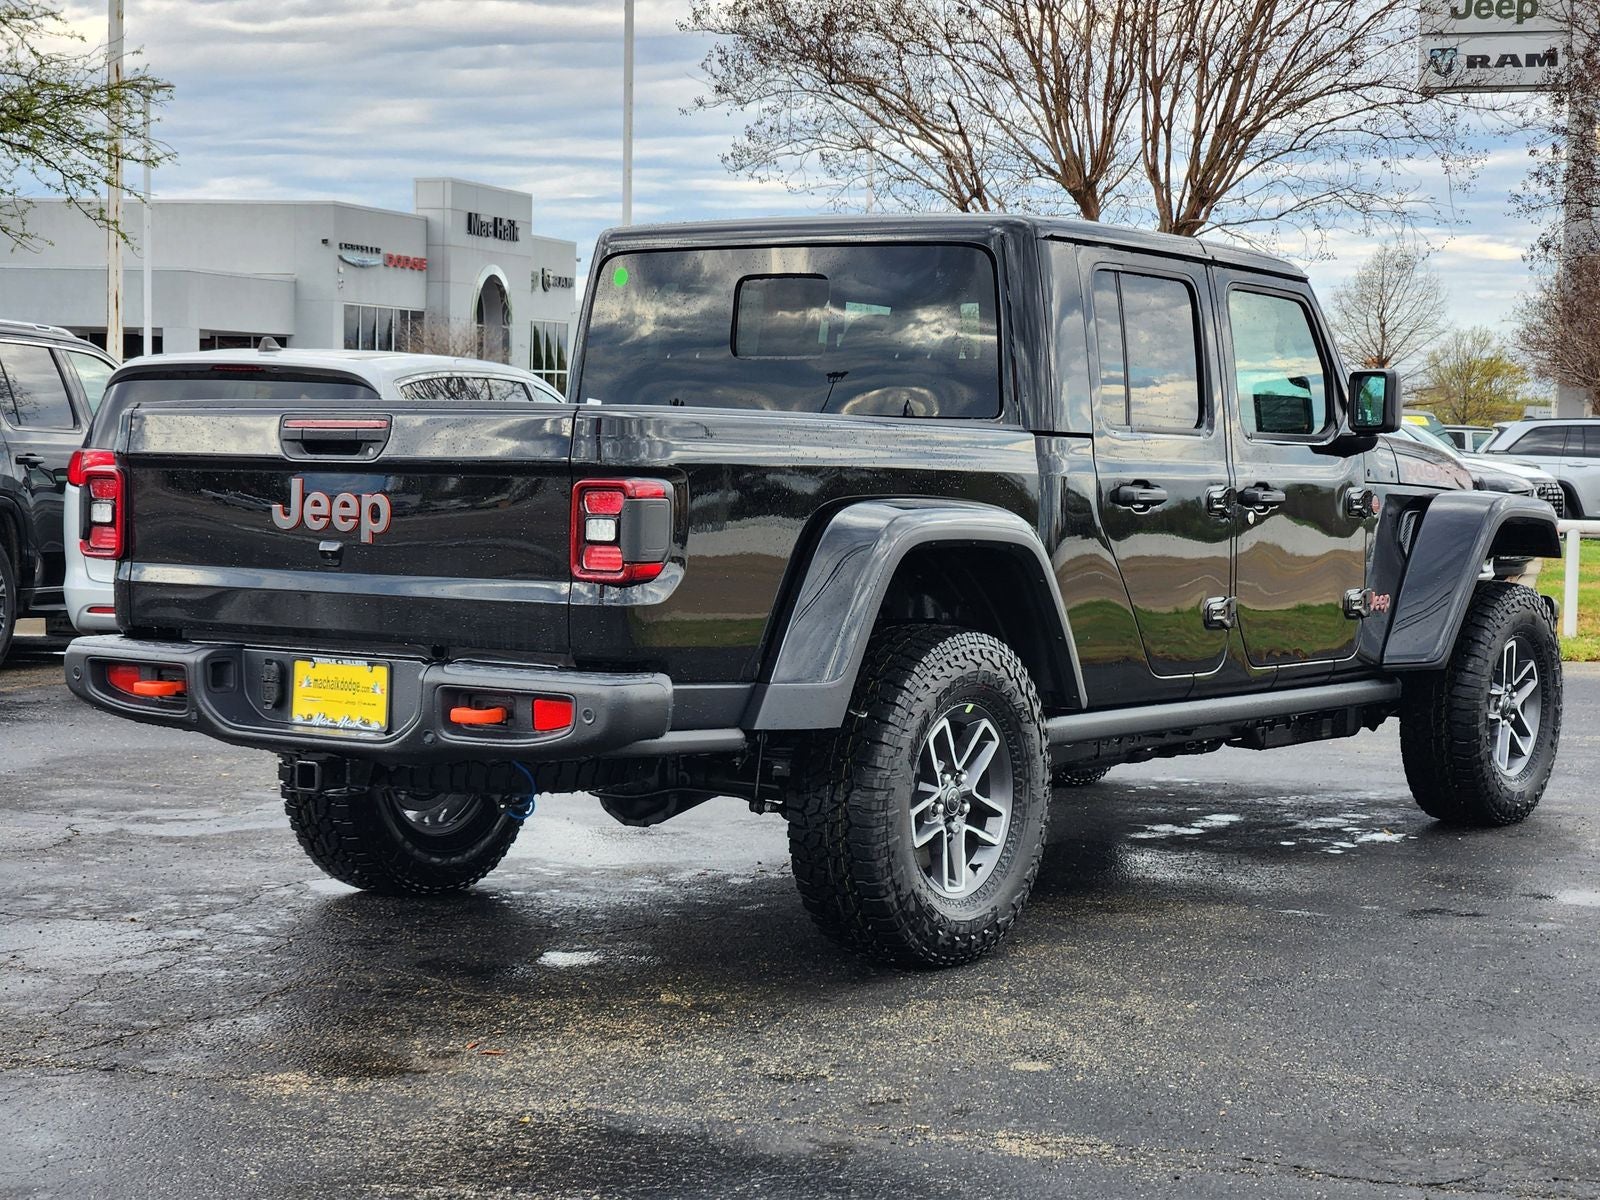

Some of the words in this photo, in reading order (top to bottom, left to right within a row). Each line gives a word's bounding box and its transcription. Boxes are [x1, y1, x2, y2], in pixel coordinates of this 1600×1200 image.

[1451, 0, 1539, 25] Jeep
[1466, 53, 1558, 69] RAM
[467, 212, 493, 238] Mac
[493, 216, 520, 242] Haik
[384, 253, 428, 271] DODGE
[271, 477, 392, 544] Jeep
[1370, 591, 1390, 613] Jeep
[311, 711, 337, 727] Mac
